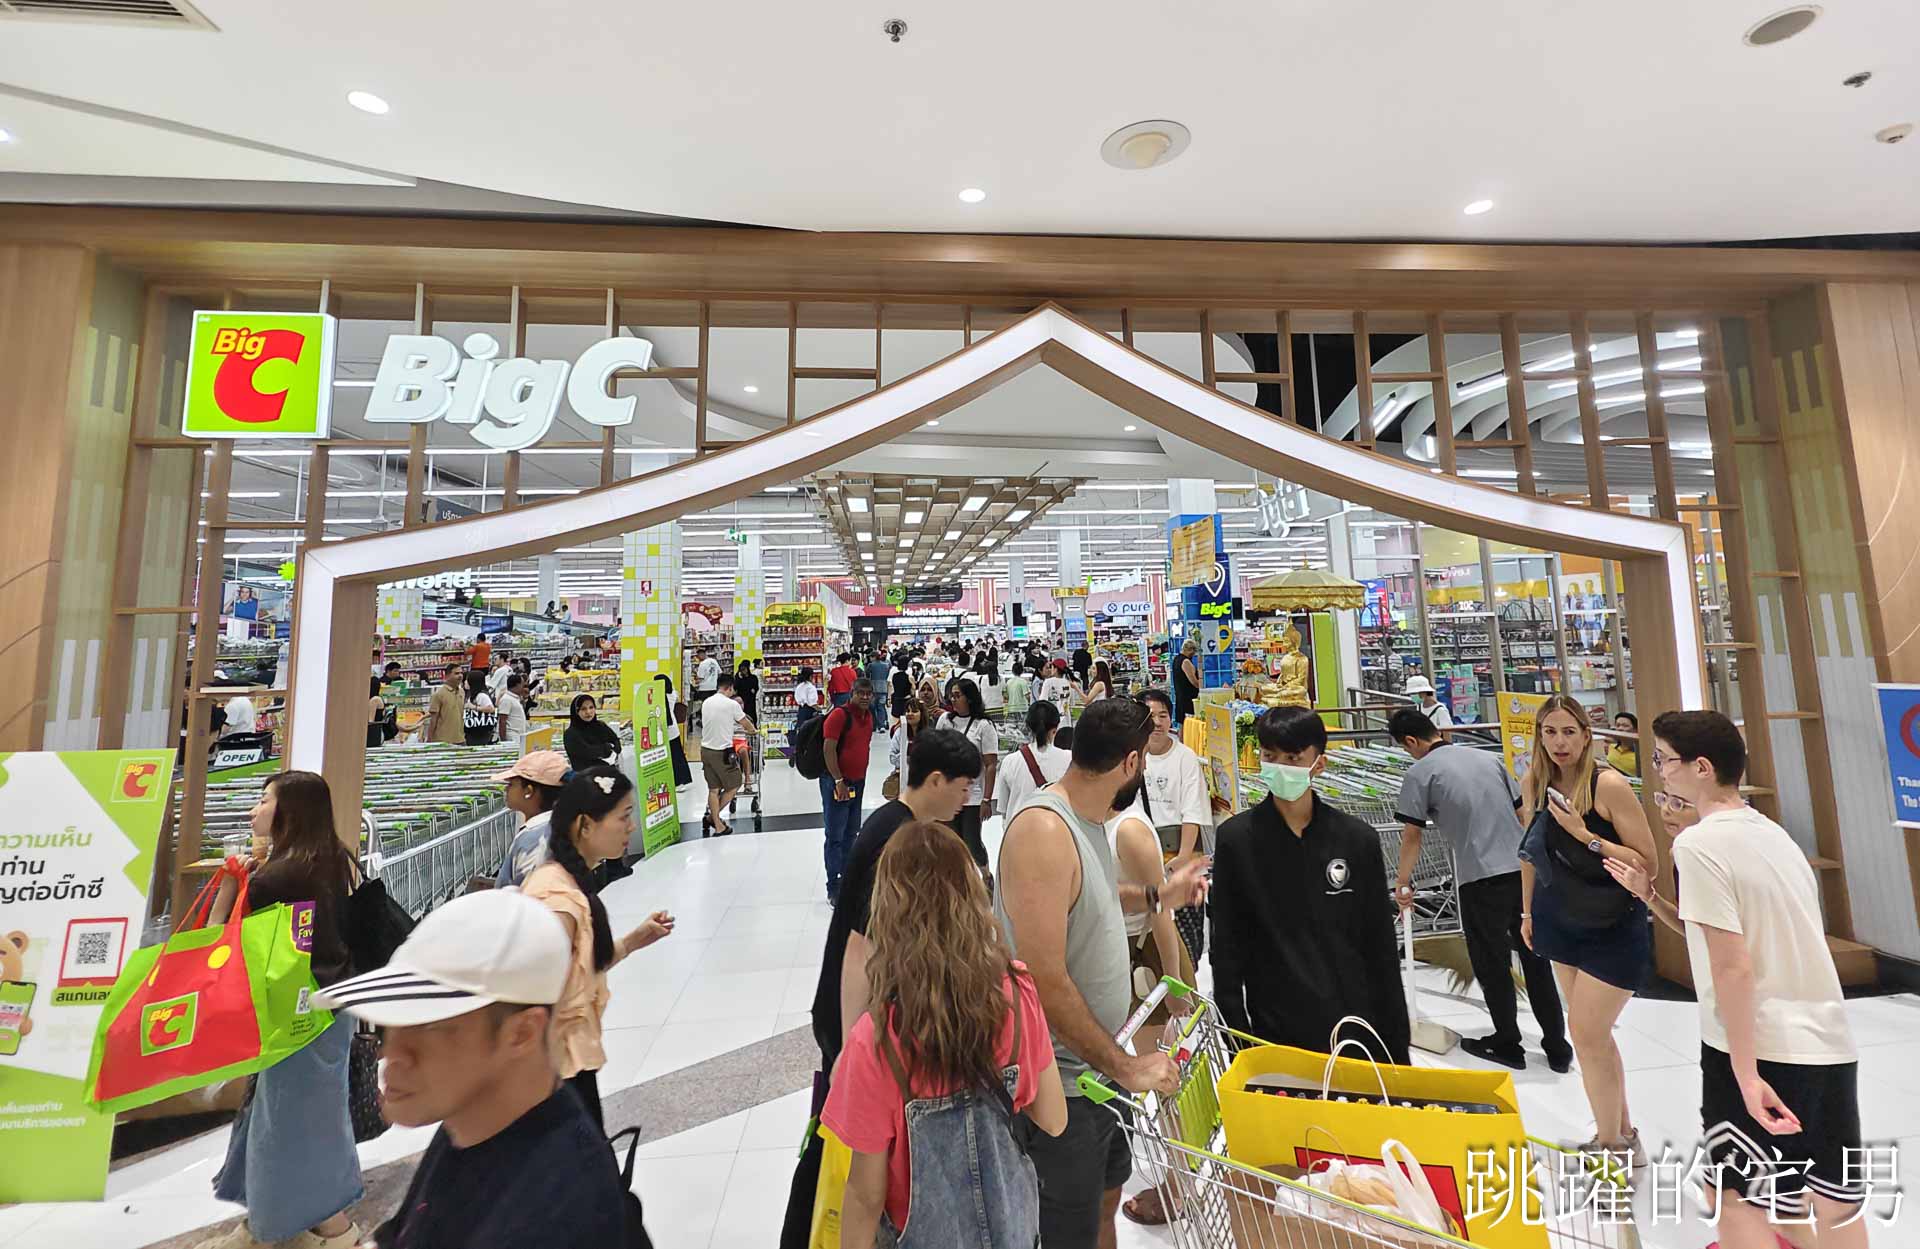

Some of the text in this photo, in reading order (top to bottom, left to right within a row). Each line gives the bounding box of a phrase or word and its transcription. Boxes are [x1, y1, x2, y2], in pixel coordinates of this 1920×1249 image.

[213, 328, 267, 360] Big
[895, 588, 903, 600] 3
[1122, 603, 1151, 614] pure
[221, 752, 256, 764] OPEN
[150, 1008, 173, 1021] Big
